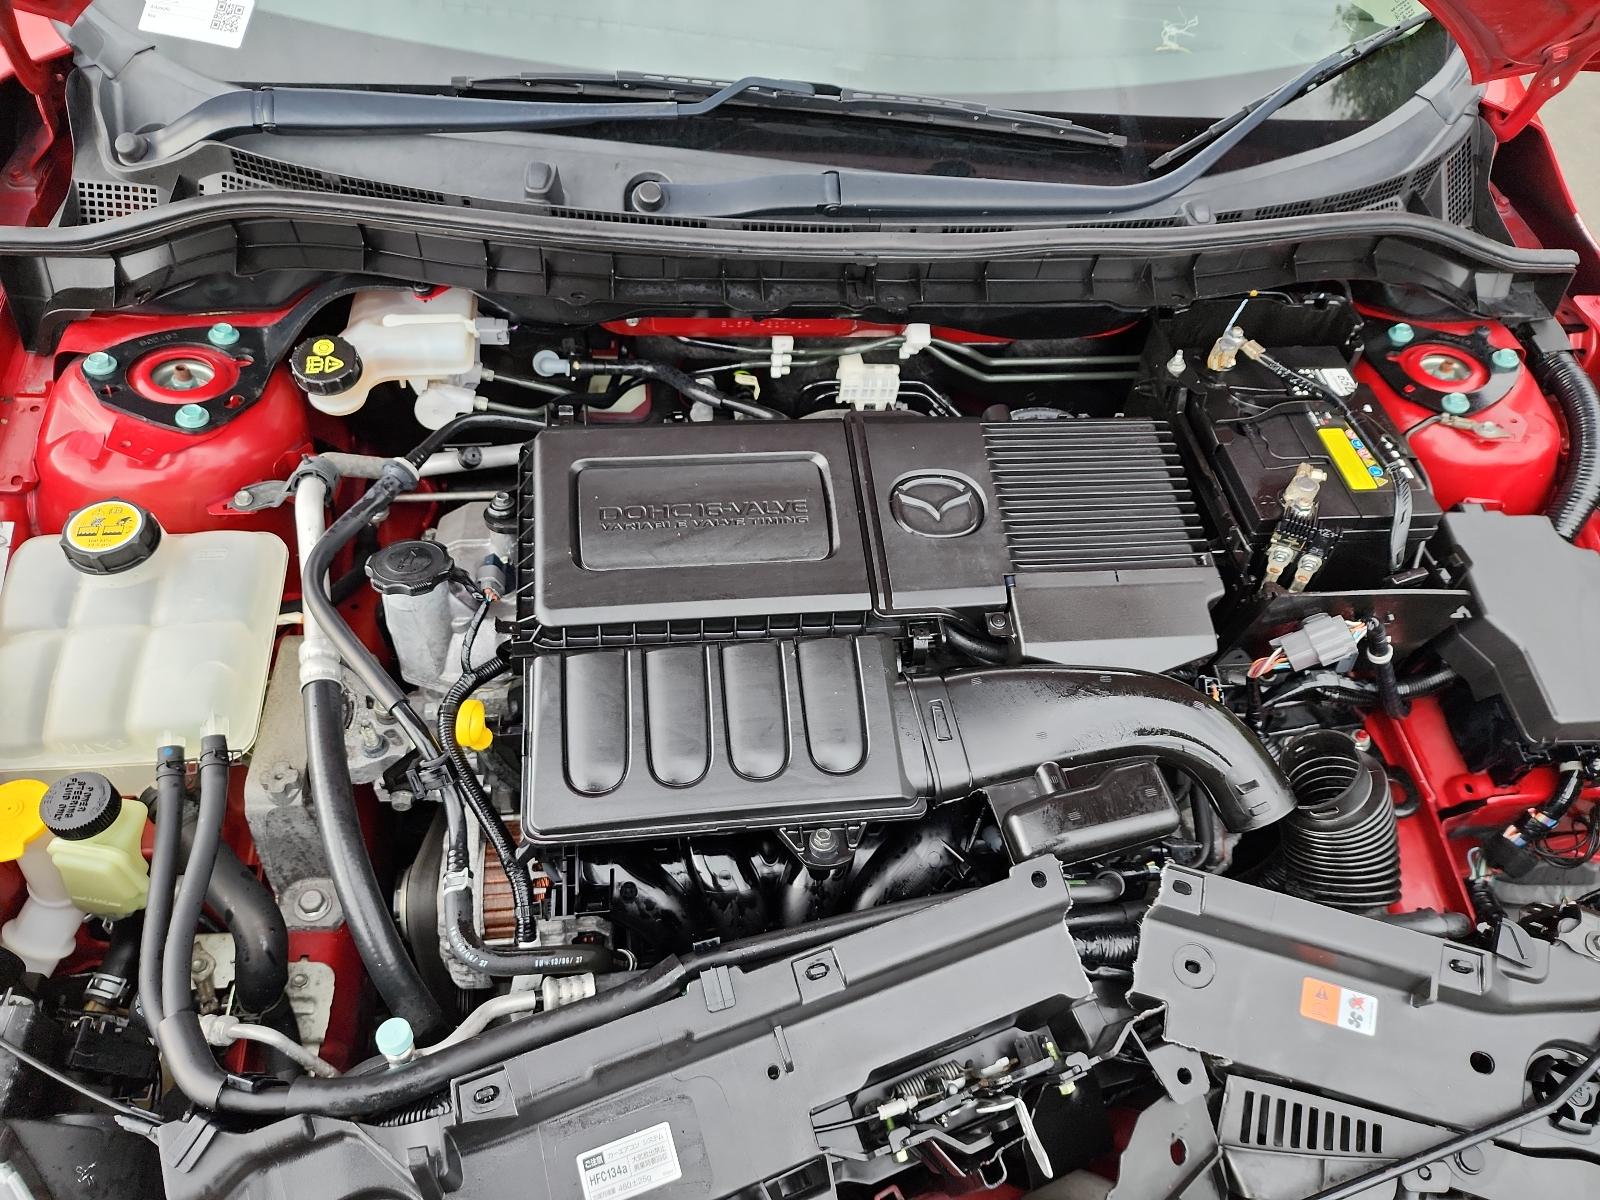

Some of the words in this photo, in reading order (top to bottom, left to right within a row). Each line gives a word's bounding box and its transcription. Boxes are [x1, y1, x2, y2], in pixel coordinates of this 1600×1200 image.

[600, 503, 693, 520] DOHC
[696, 498, 809, 517] 16-VALVE
[600, 519, 688, 531] VARIABLE
[693, 517, 746, 529] VALVE
[749, 515, 809, 526] TIMING
[63, 778, 78, 800] FLUID
[65, 781, 87, 818] STEERING
[77, 786, 94, 812] POWER
[53, 803, 67, 821] ONLY
[589, 1164, 628, 1187] HFC134a
